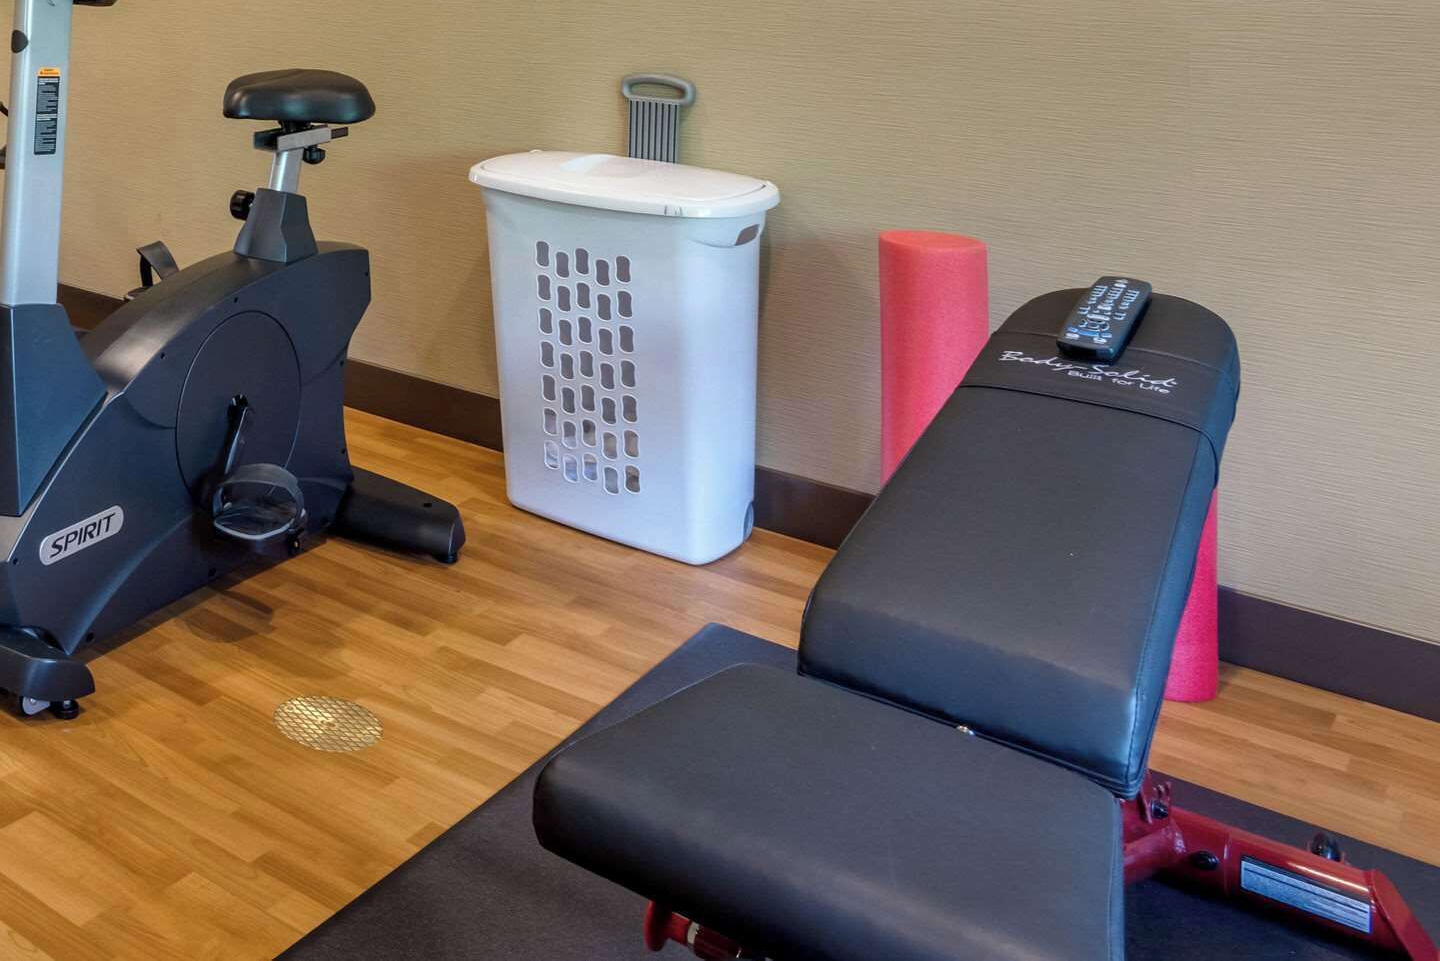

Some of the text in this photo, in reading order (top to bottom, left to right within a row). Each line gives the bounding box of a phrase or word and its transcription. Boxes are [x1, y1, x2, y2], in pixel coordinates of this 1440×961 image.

[1067, 370, 1170, 394] Built for Life
[48, 513, 116, 559] SPIRIT
